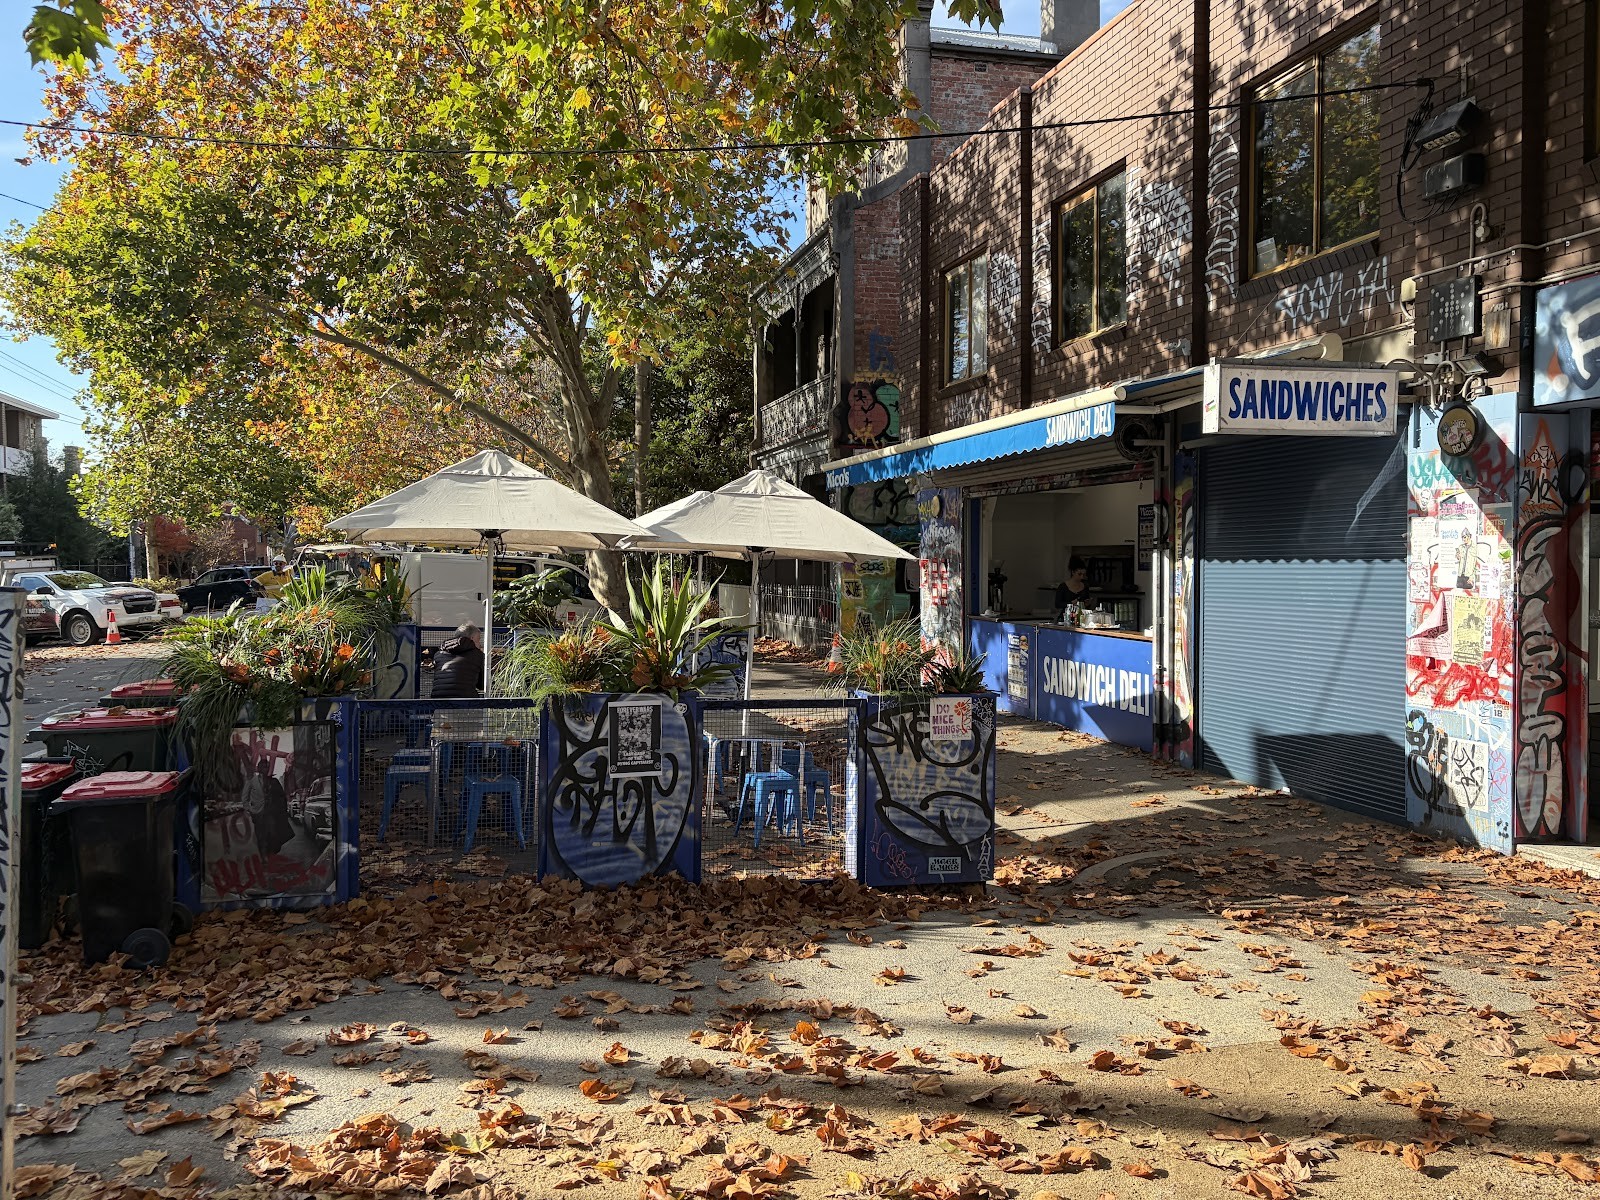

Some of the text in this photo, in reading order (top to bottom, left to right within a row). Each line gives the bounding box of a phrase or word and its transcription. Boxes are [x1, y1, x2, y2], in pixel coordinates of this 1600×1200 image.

[1228, 377, 1387, 422] SANDWICHES
[1046, 402, 1112, 445] SANDWICH DELI
[827, 468, 849, 488] Nico's
[1043, 655, 1116, 709] SANDWICH
[1119, 669, 1150, 717] DELI
[936, 704, 950, 715] DO
[932, 715, 954, 725] NICE
[932, 725, 960, 735] THINGS
